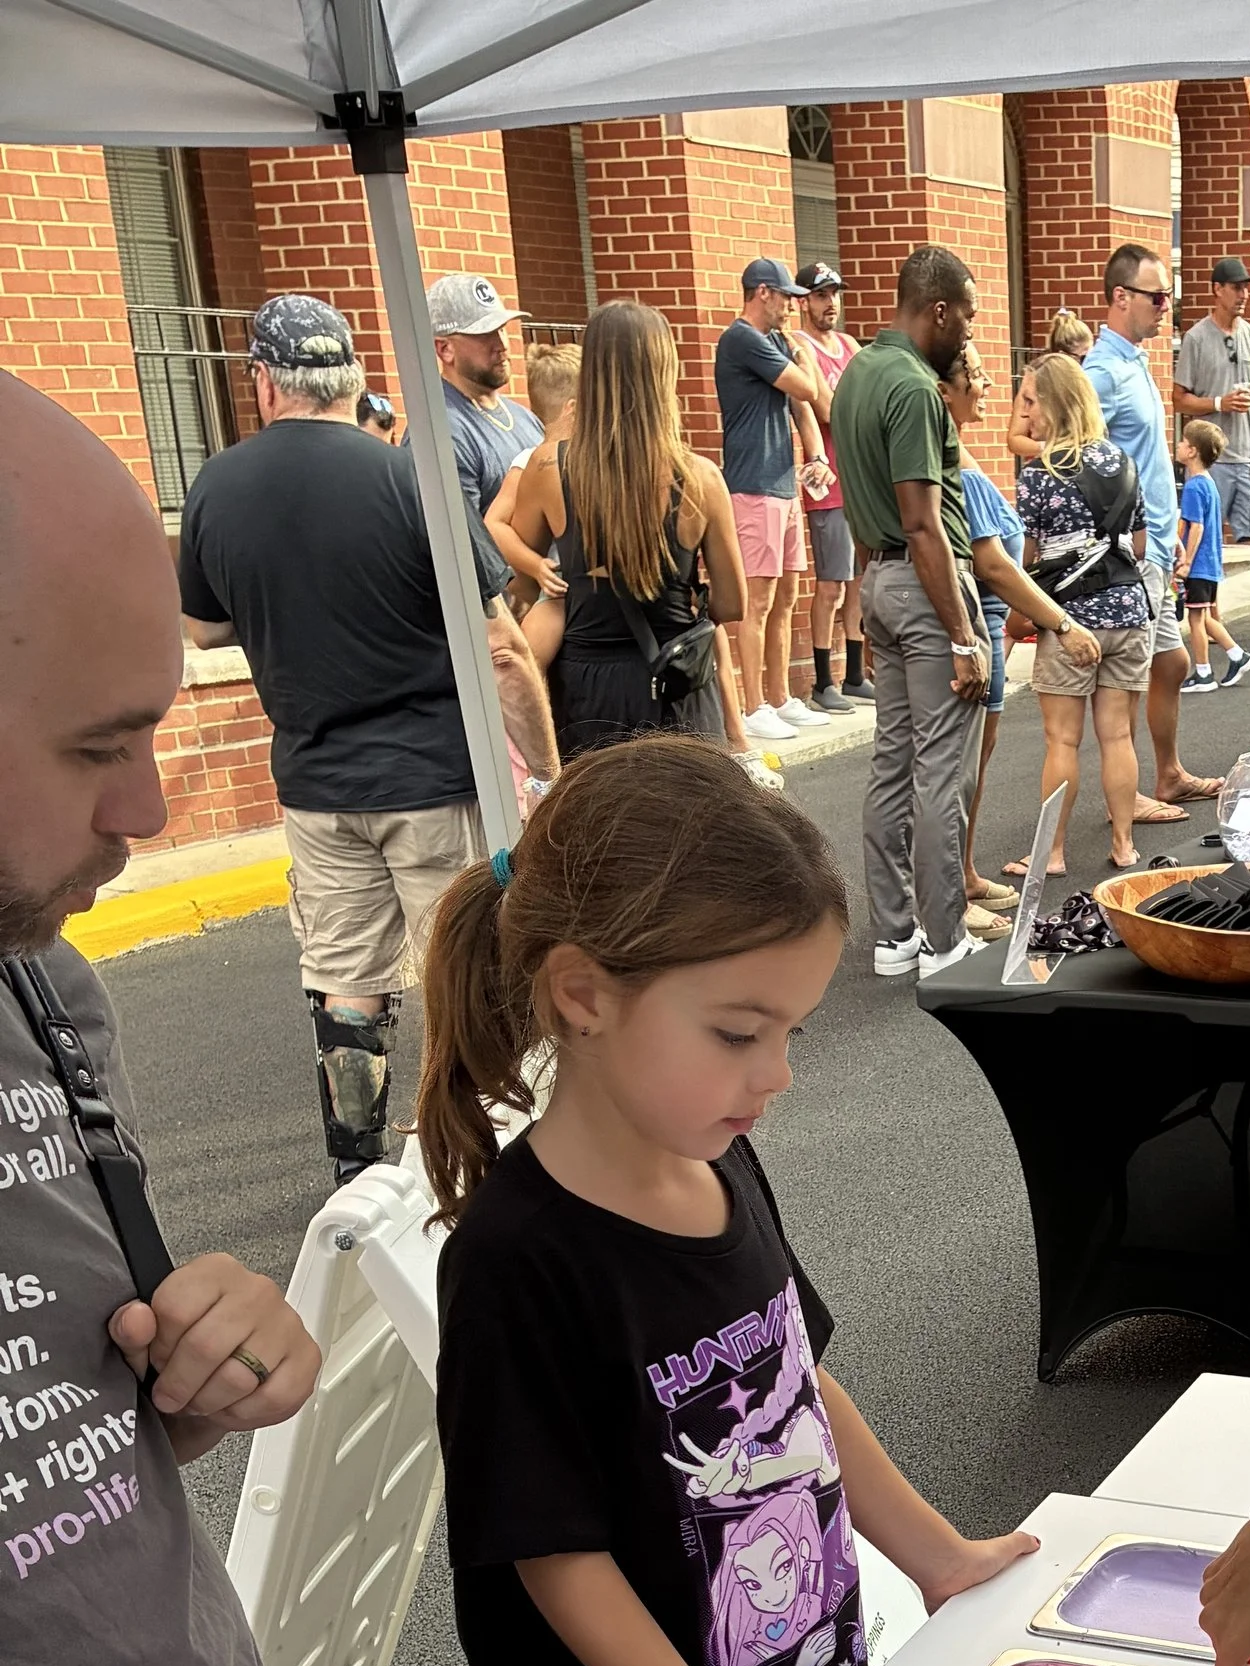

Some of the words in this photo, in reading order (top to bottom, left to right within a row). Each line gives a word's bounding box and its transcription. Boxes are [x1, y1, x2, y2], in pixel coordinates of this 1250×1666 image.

[0, 1079, 70, 1133] ights
[27, 1134, 76, 1182] all.
[0, 1381, 99, 1445] form.
[679, 1516, 699, 1558] MIRA
